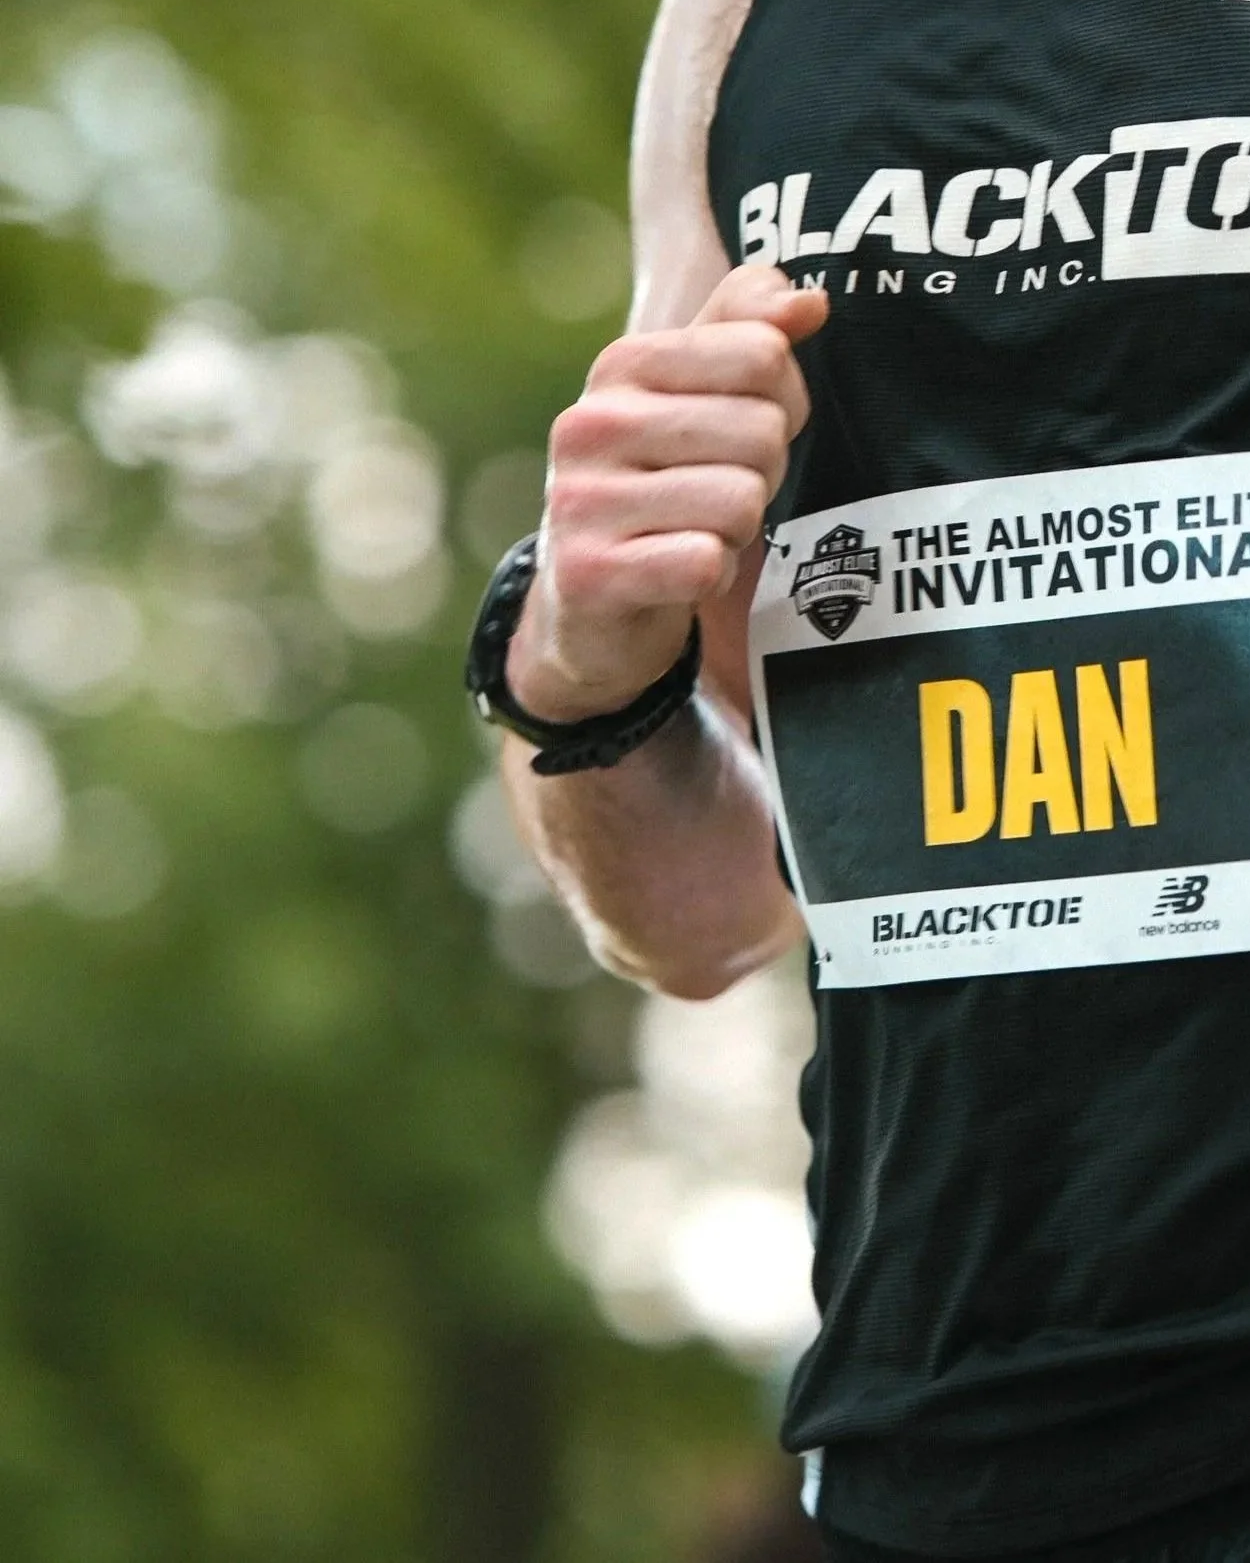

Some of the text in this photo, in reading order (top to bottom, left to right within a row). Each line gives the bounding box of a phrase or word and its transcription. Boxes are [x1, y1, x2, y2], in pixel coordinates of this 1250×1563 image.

[995, 260, 1096, 295] INC.
[893, 521, 971, 563] THE
[986, 501, 1160, 553] ALMOST
[919, 658, 1158, 847] DAN
[873, 896, 1083, 942] BLACKTOE
